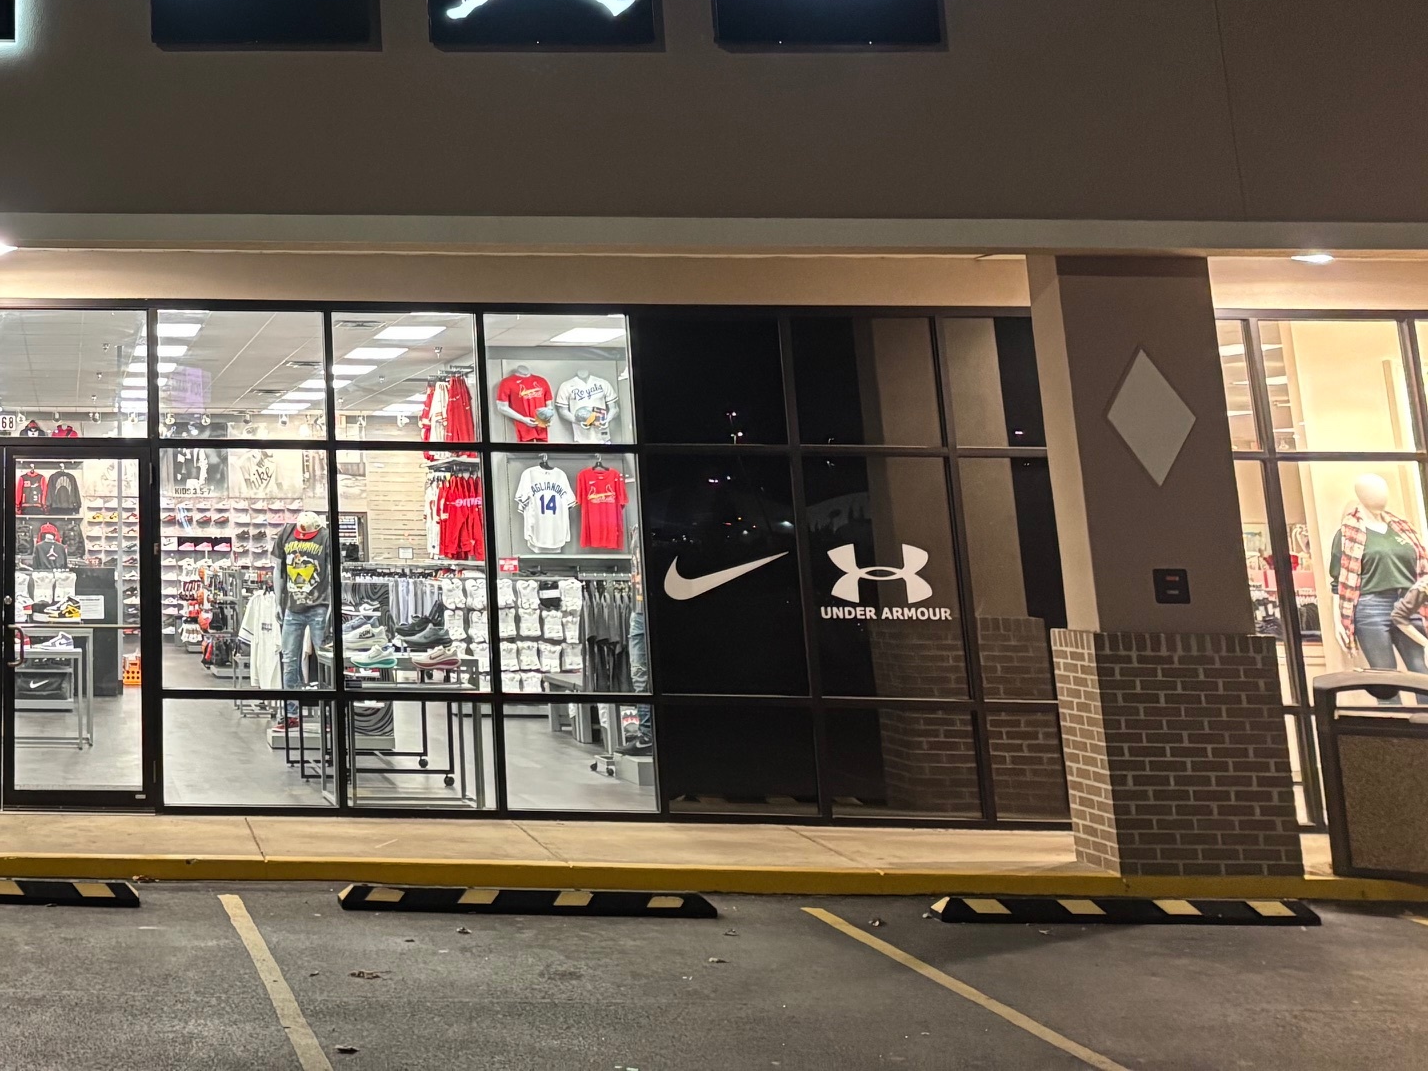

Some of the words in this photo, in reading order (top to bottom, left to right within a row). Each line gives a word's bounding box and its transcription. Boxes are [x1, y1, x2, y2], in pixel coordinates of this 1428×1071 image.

[571, 383, 604, 402] Royals
[174, 487, 192, 495] KIDS
[539, 493, 557, 516] 14
[820, 606, 878, 620] UNDER
[881, 607, 953, 621] ARMOUR
